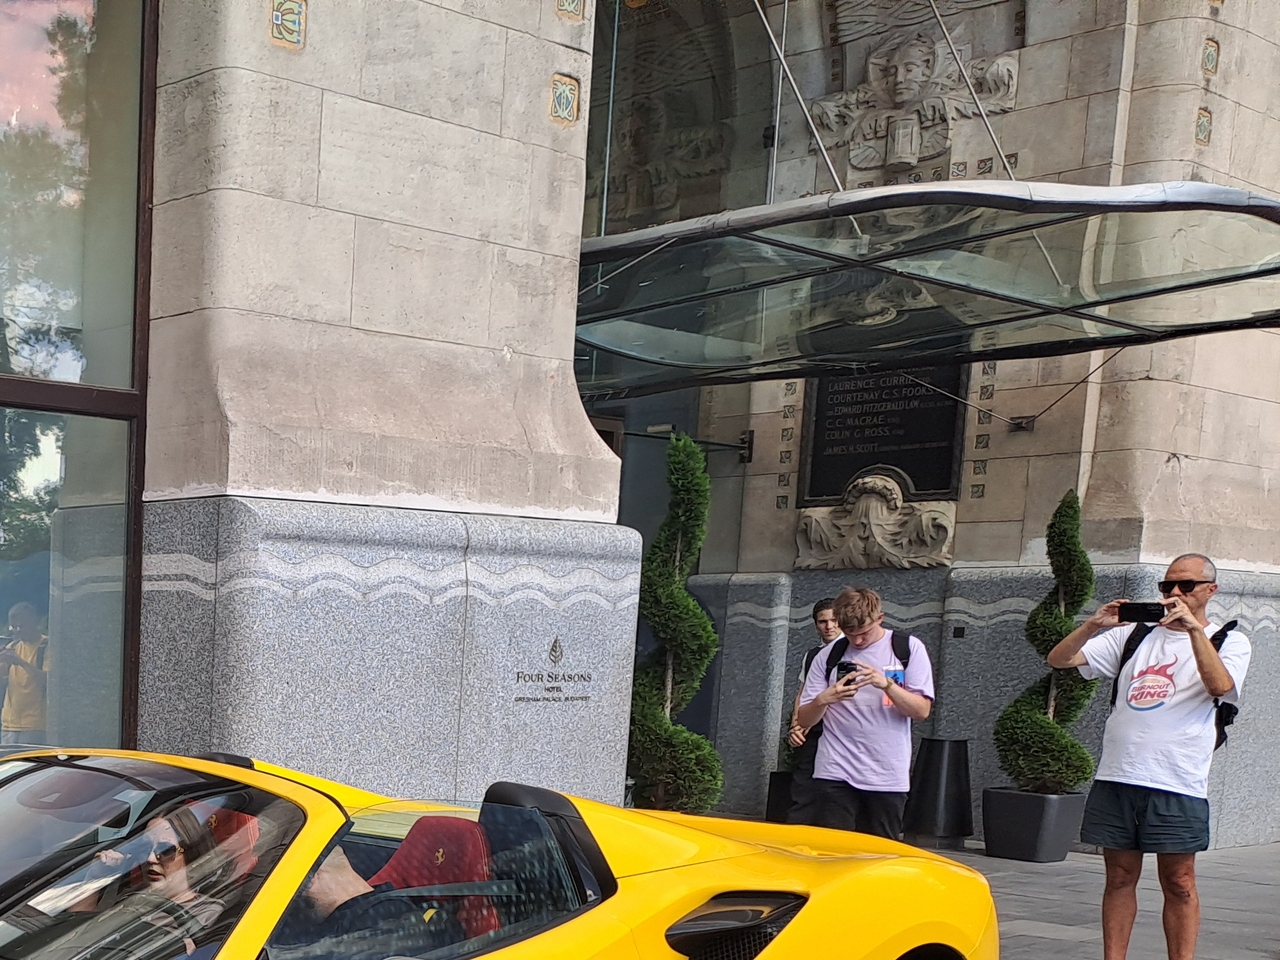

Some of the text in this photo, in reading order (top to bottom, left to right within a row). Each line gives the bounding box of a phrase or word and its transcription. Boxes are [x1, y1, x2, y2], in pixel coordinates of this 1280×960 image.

[828, 378, 876, 392] LAURENCE
[827, 390, 881, 404] COURTENAY
[825, 429, 850, 440] COLIN
[1128, 690, 1169, 703] KING
